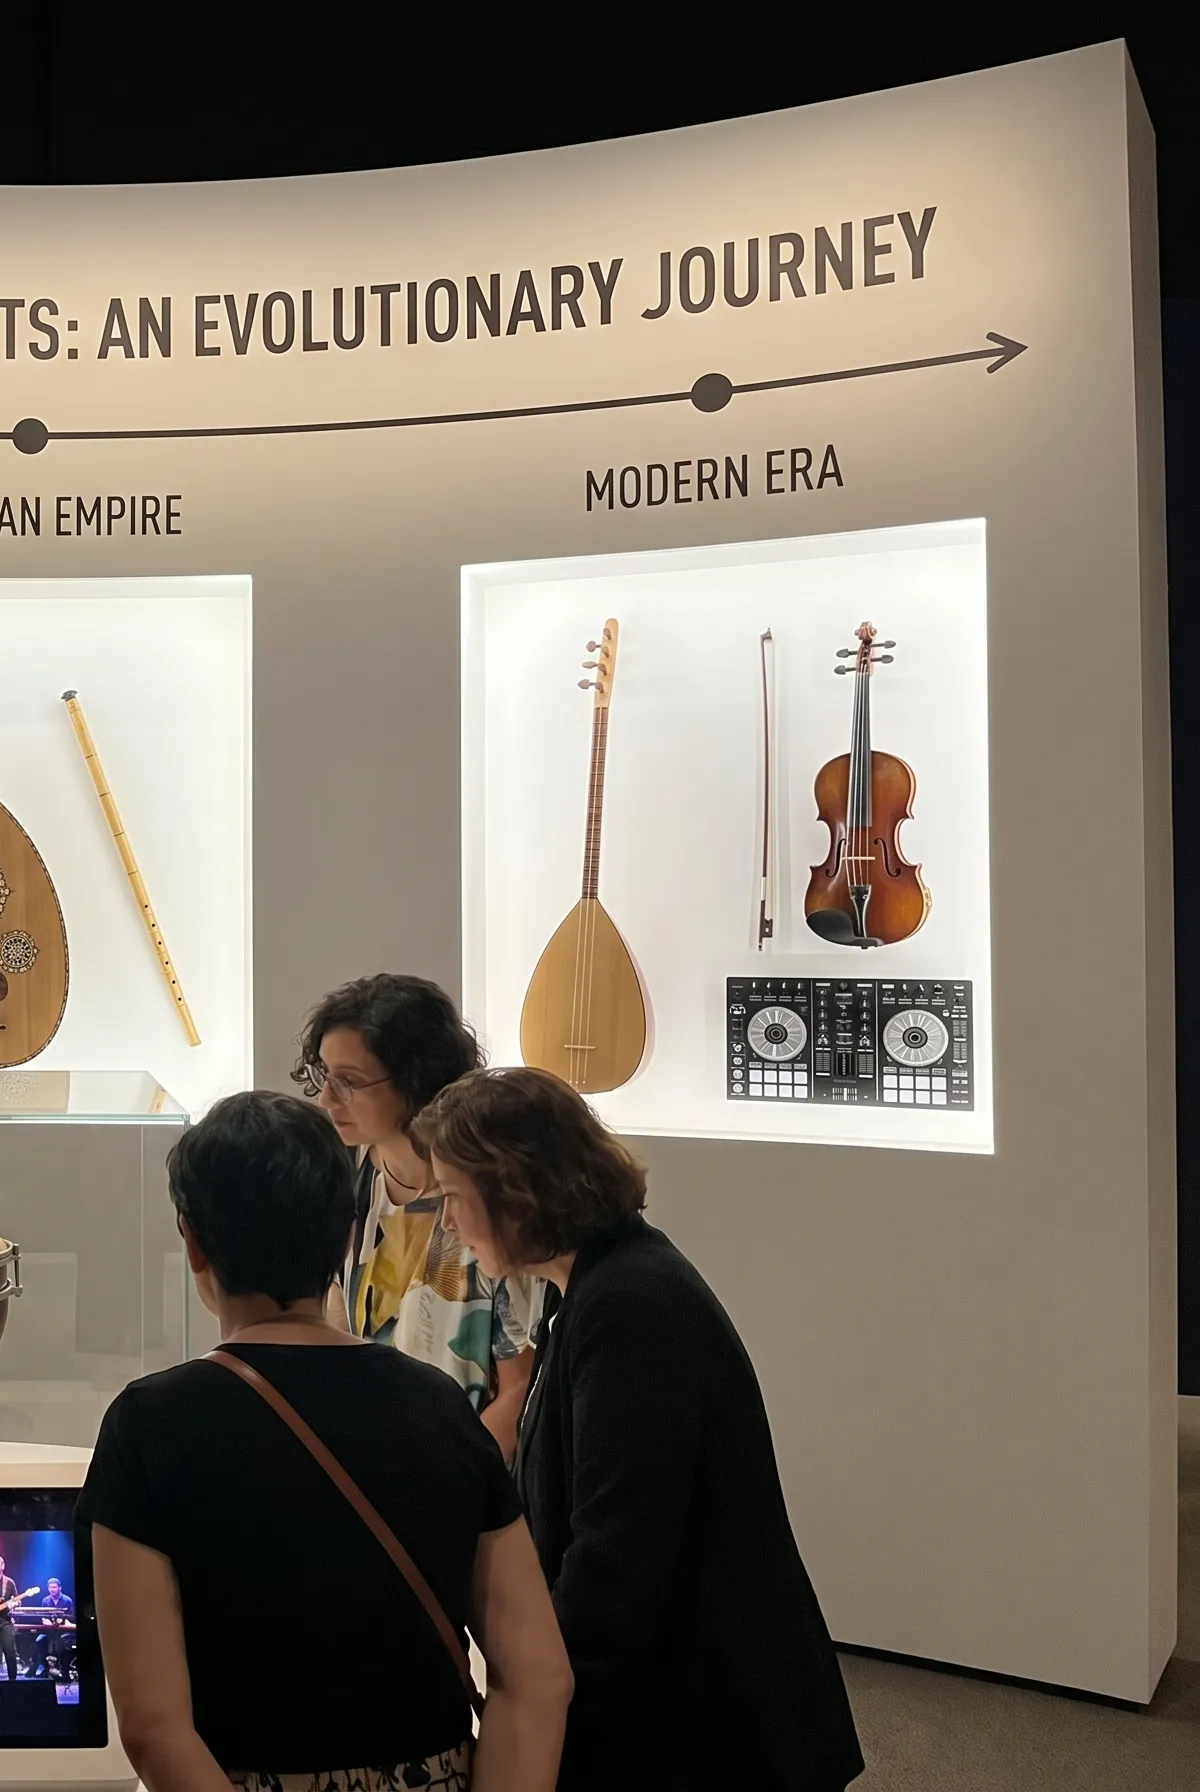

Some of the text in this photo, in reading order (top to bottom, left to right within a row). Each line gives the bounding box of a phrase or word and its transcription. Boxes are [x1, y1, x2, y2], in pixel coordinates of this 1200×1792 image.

[96, 296, 172, 360] AN
[194, 257, 624, 357] EVOLUTIONARY
[640, 206, 938, 320] JOURNEY
[586, 443, 844, 512] MODERN ERA
[55, 494, 182, 537] EMPIRE
